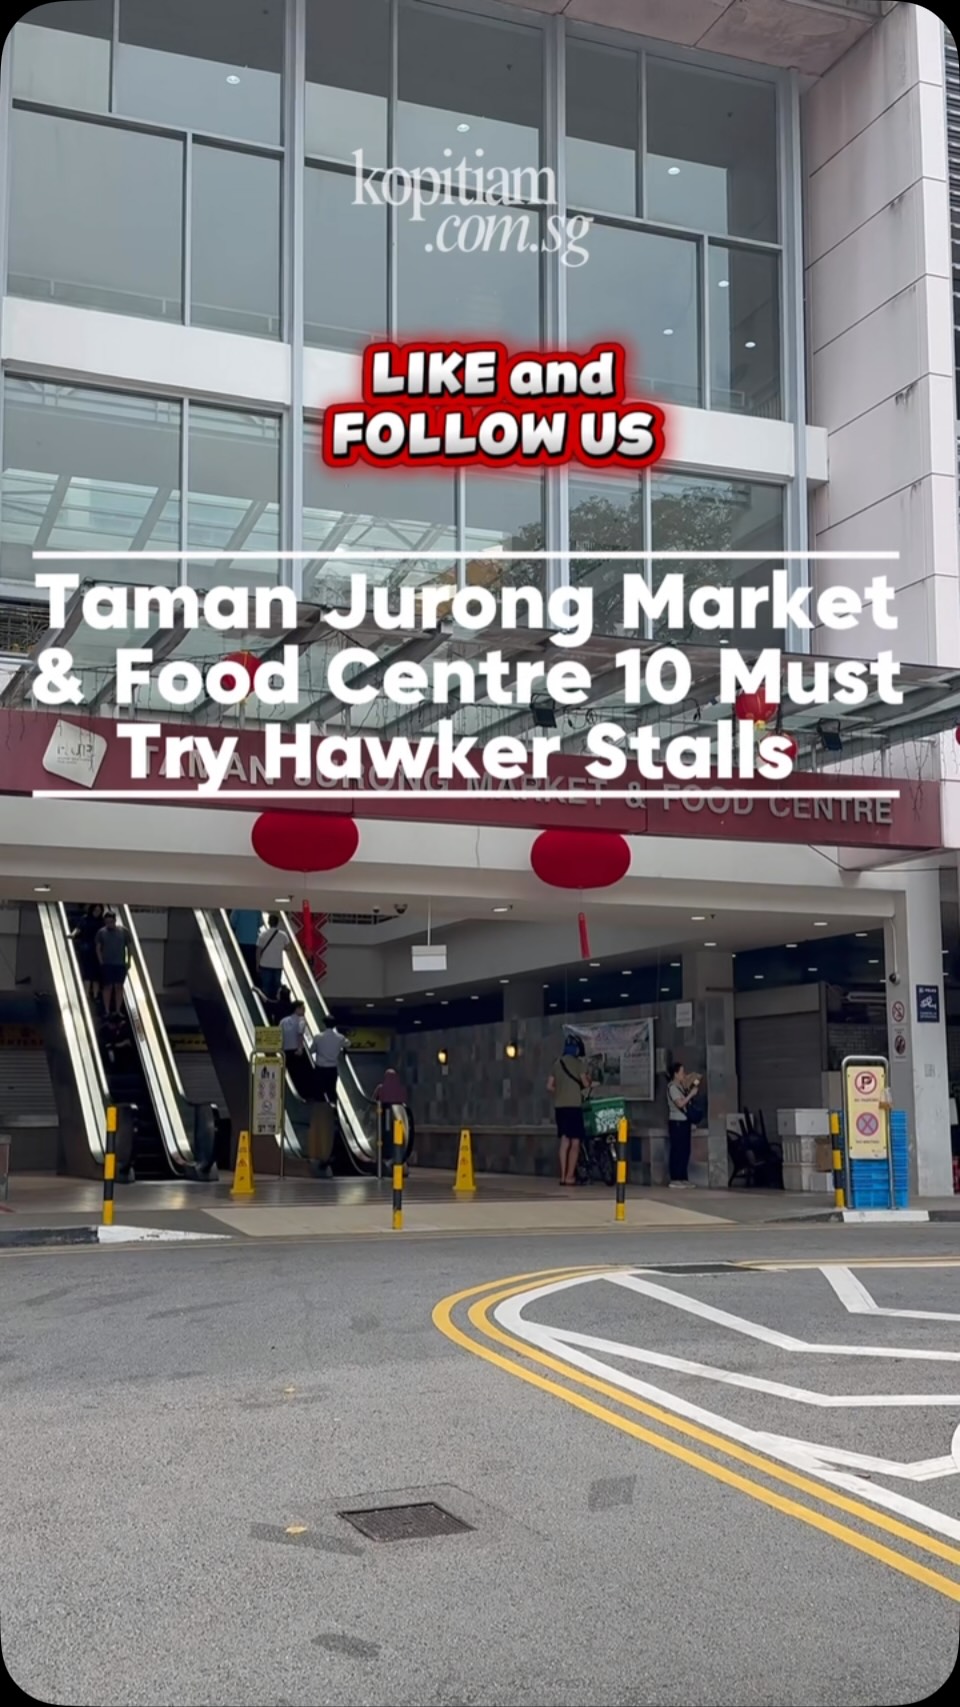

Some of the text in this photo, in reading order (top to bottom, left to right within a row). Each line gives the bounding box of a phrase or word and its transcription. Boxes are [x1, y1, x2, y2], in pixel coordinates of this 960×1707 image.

[626, 781, 647, 809] &
[663, 783, 754, 815] FOOD
[768, 795, 893, 824] CENTRE
